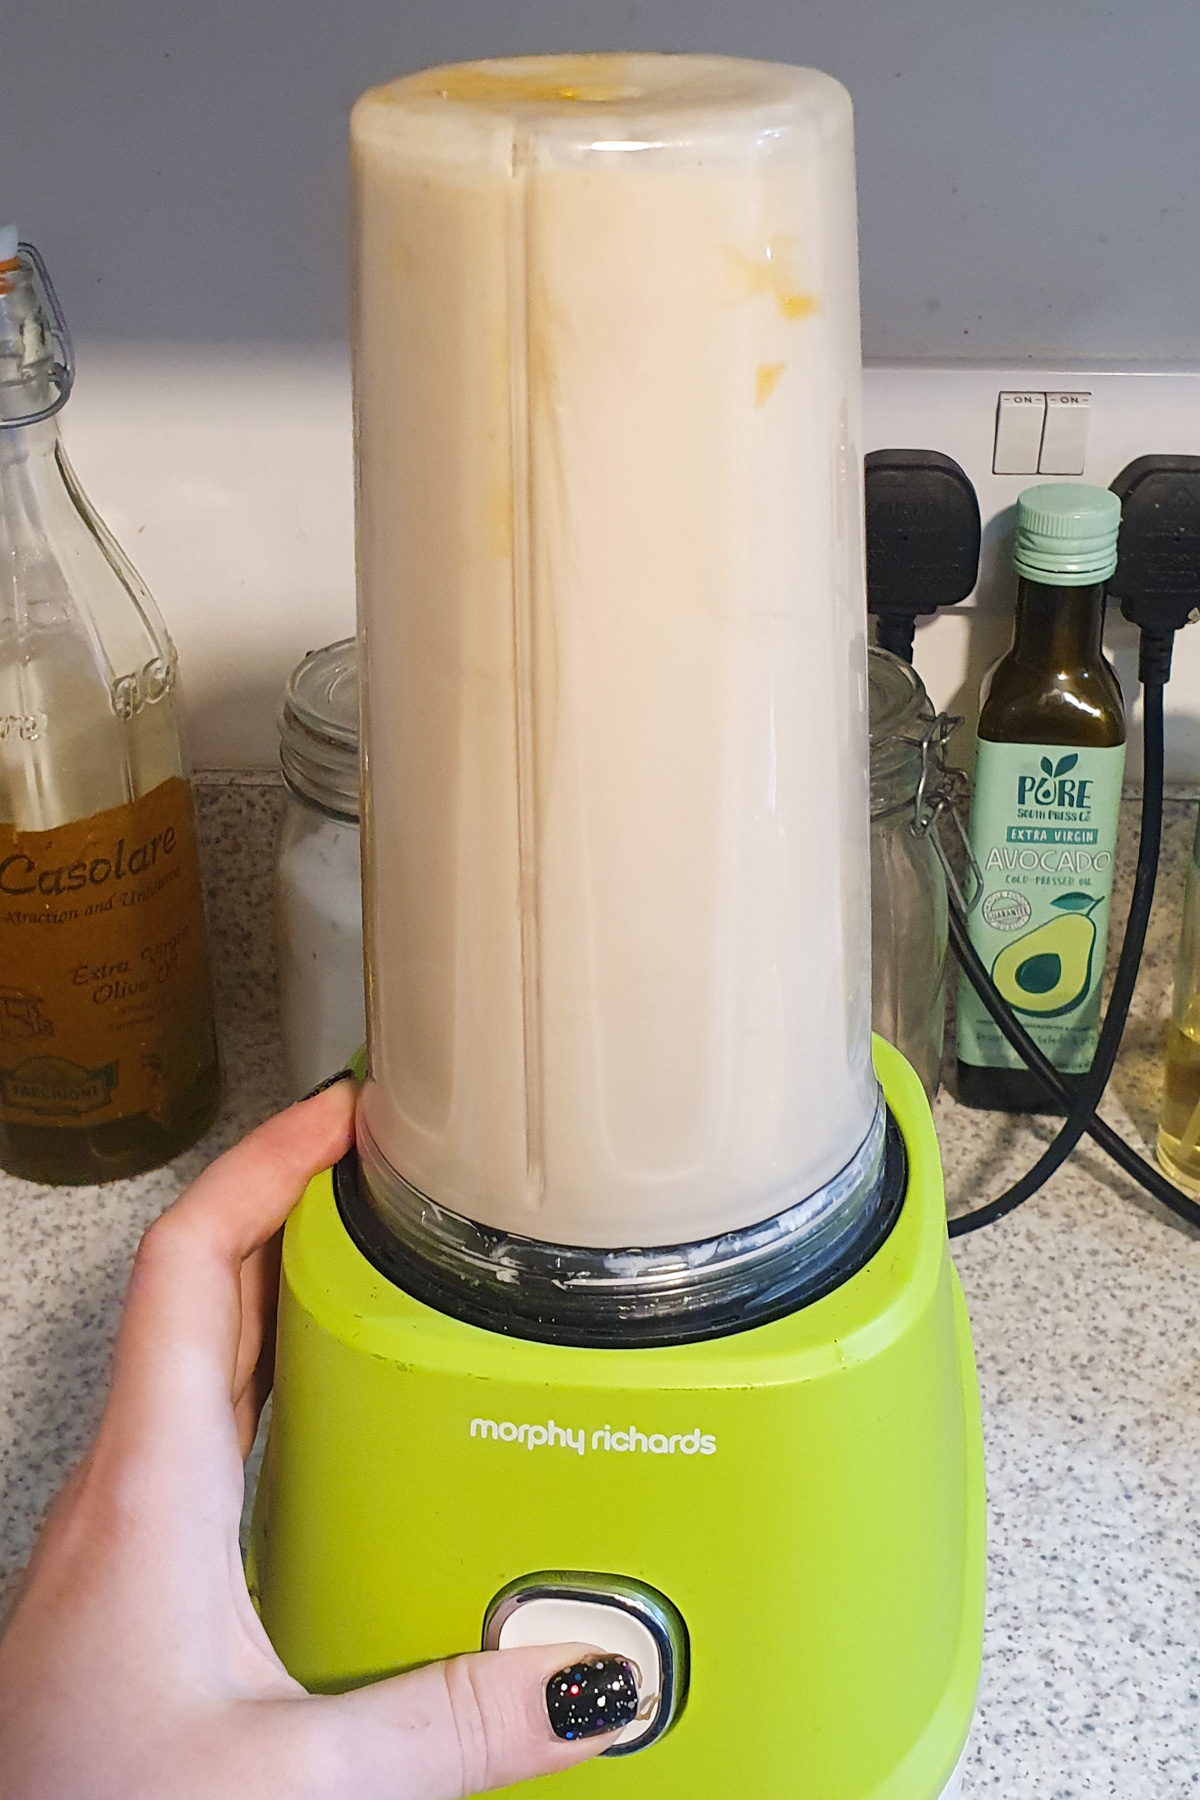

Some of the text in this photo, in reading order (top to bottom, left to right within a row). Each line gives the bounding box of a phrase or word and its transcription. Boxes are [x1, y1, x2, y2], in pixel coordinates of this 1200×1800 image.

[1017, 775, 1094, 809] PURE
[1010, 828, 1094, 843] EXTRA VIRGIN
[0, 825, 177, 896] Casolare
[985, 848, 1112, 873] AVOCADO
[84, 892, 117, 916] and
[70, 960, 130, 986] Extra
[93, 980, 149, 1004] Olive
[470, 1417, 717, 1456] morphy richards
